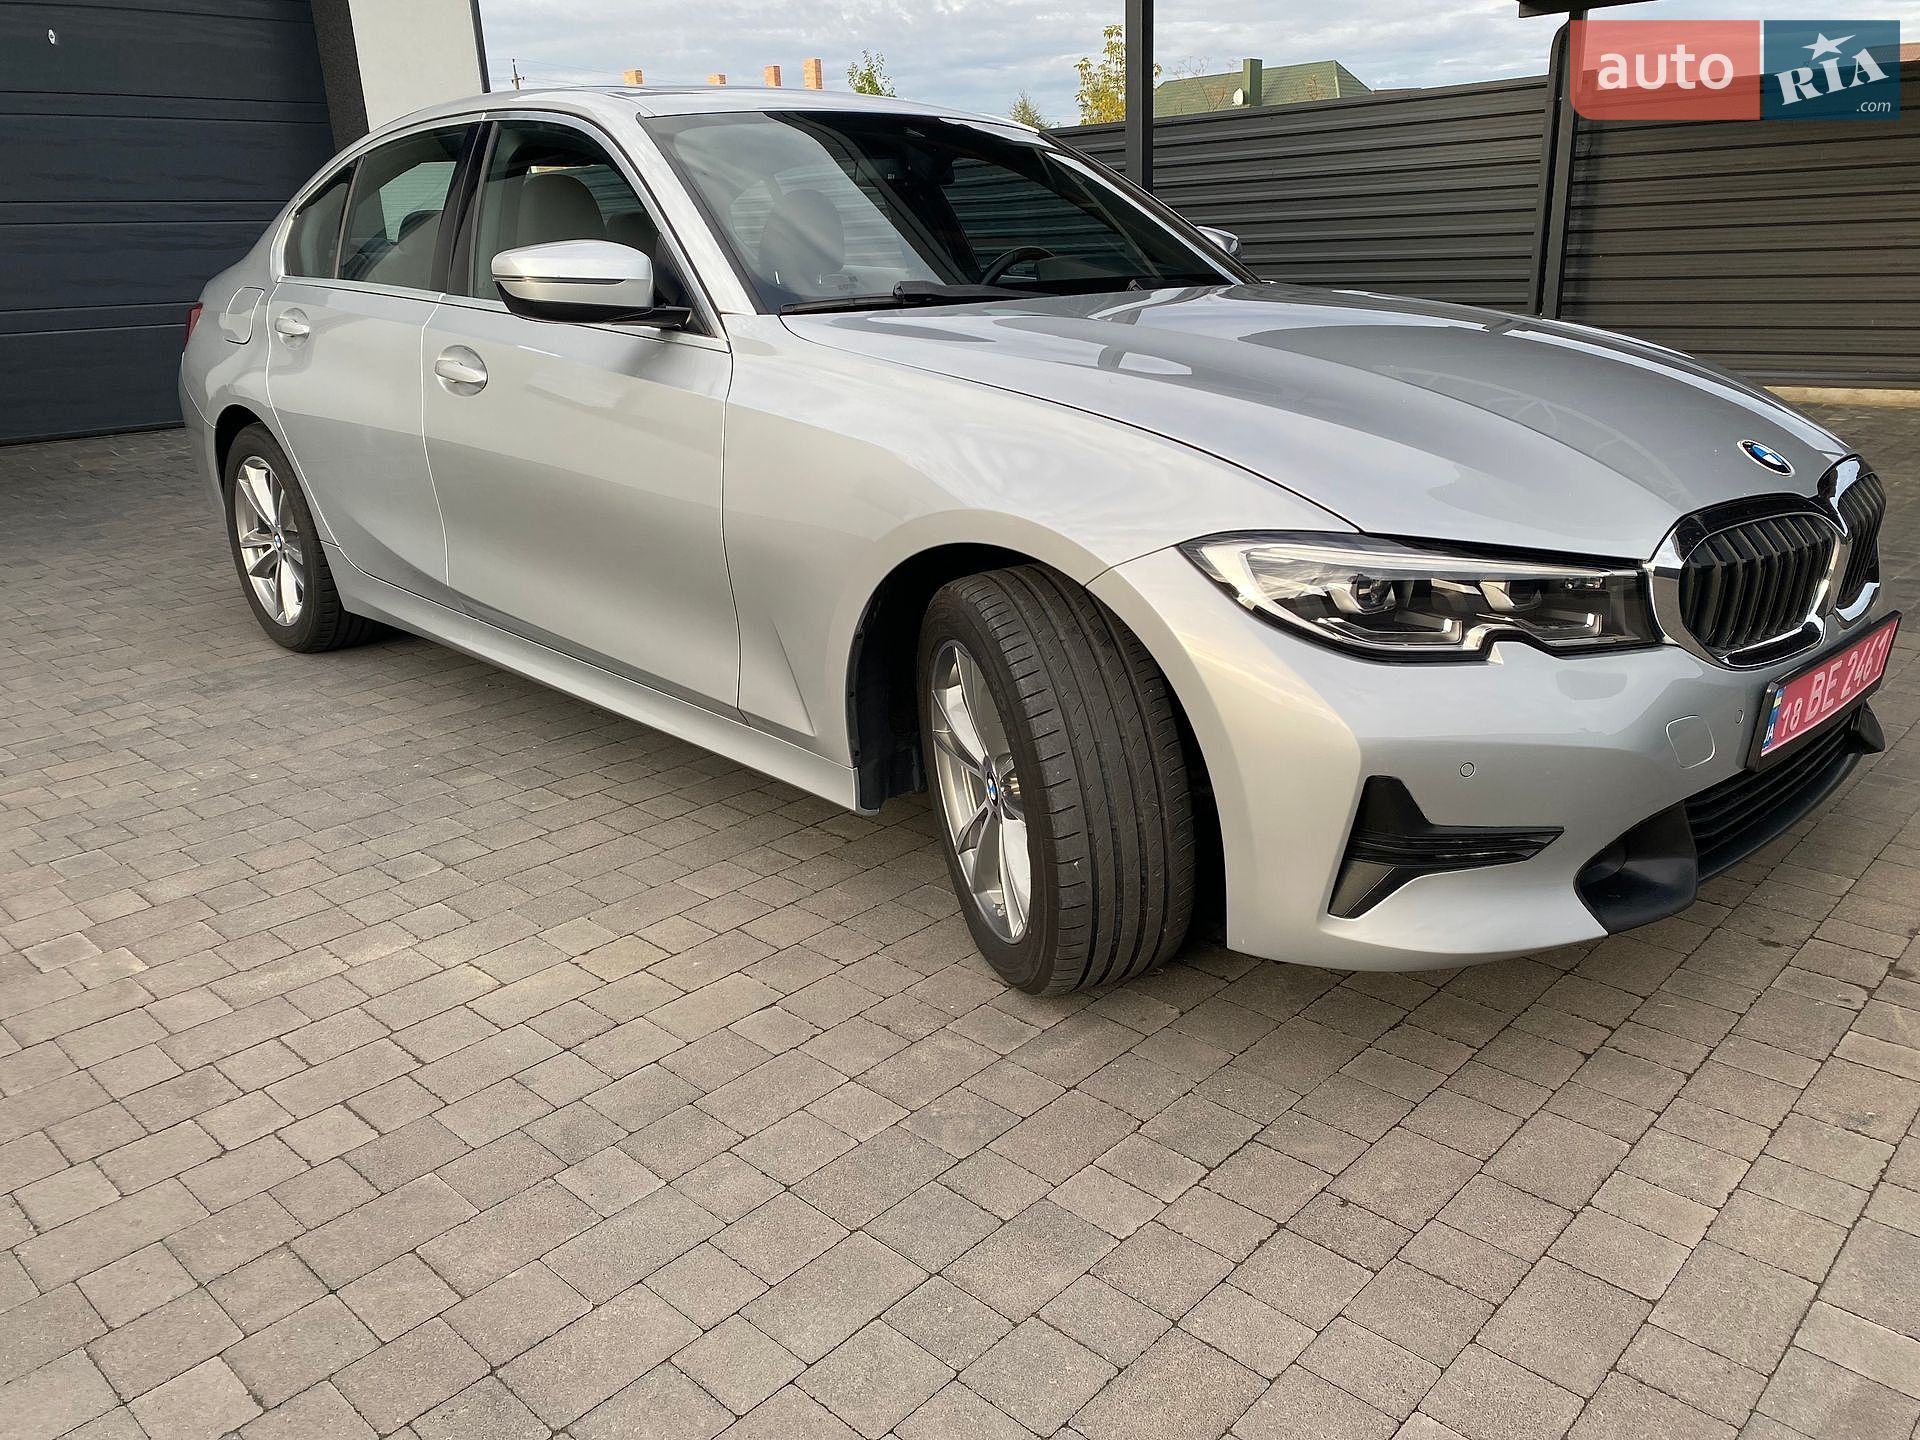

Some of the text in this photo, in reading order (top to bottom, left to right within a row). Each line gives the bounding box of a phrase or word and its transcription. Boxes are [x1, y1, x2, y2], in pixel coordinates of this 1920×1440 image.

[1782, 628, 1891, 737] 18 BE 2461
